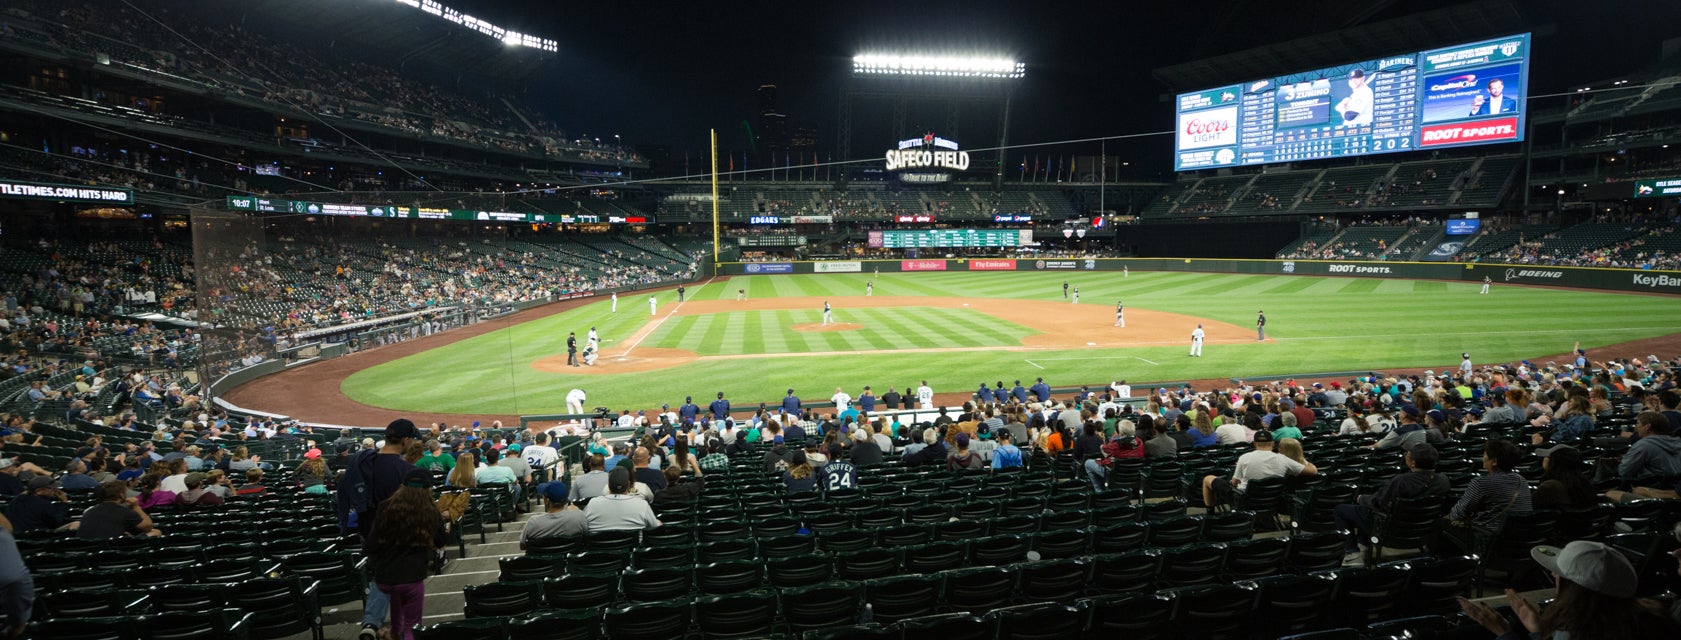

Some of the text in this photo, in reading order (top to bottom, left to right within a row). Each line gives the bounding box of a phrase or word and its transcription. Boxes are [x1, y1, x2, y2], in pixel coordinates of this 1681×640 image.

[1379, 57, 1414, 70] MARINERS
[1285, 88, 1330, 100] 3 ZUNINO
[1186, 119, 1229, 135] Coors
[1194, 132, 1221, 142] LIGHT
[1424, 128, 1462, 141] ROOT
[1373, 138, 1409, 150] 2 0 2
[886, 150, 969, 170] SAFECO FIELD
[0, 184, 127, 201] TLETIMES.COM HITS HARD
[232, 199, 250, 208] 10:07
[975, 261, 985, 269] Fly
[1329, 264, 1355, 273] ROOT
[1518, 270, 1563, 278] BOEING
[528, 457, 541, 466] 24
[825, 463, 853, 474] GRIFFEY
[829, 472, 851, 491] 24
